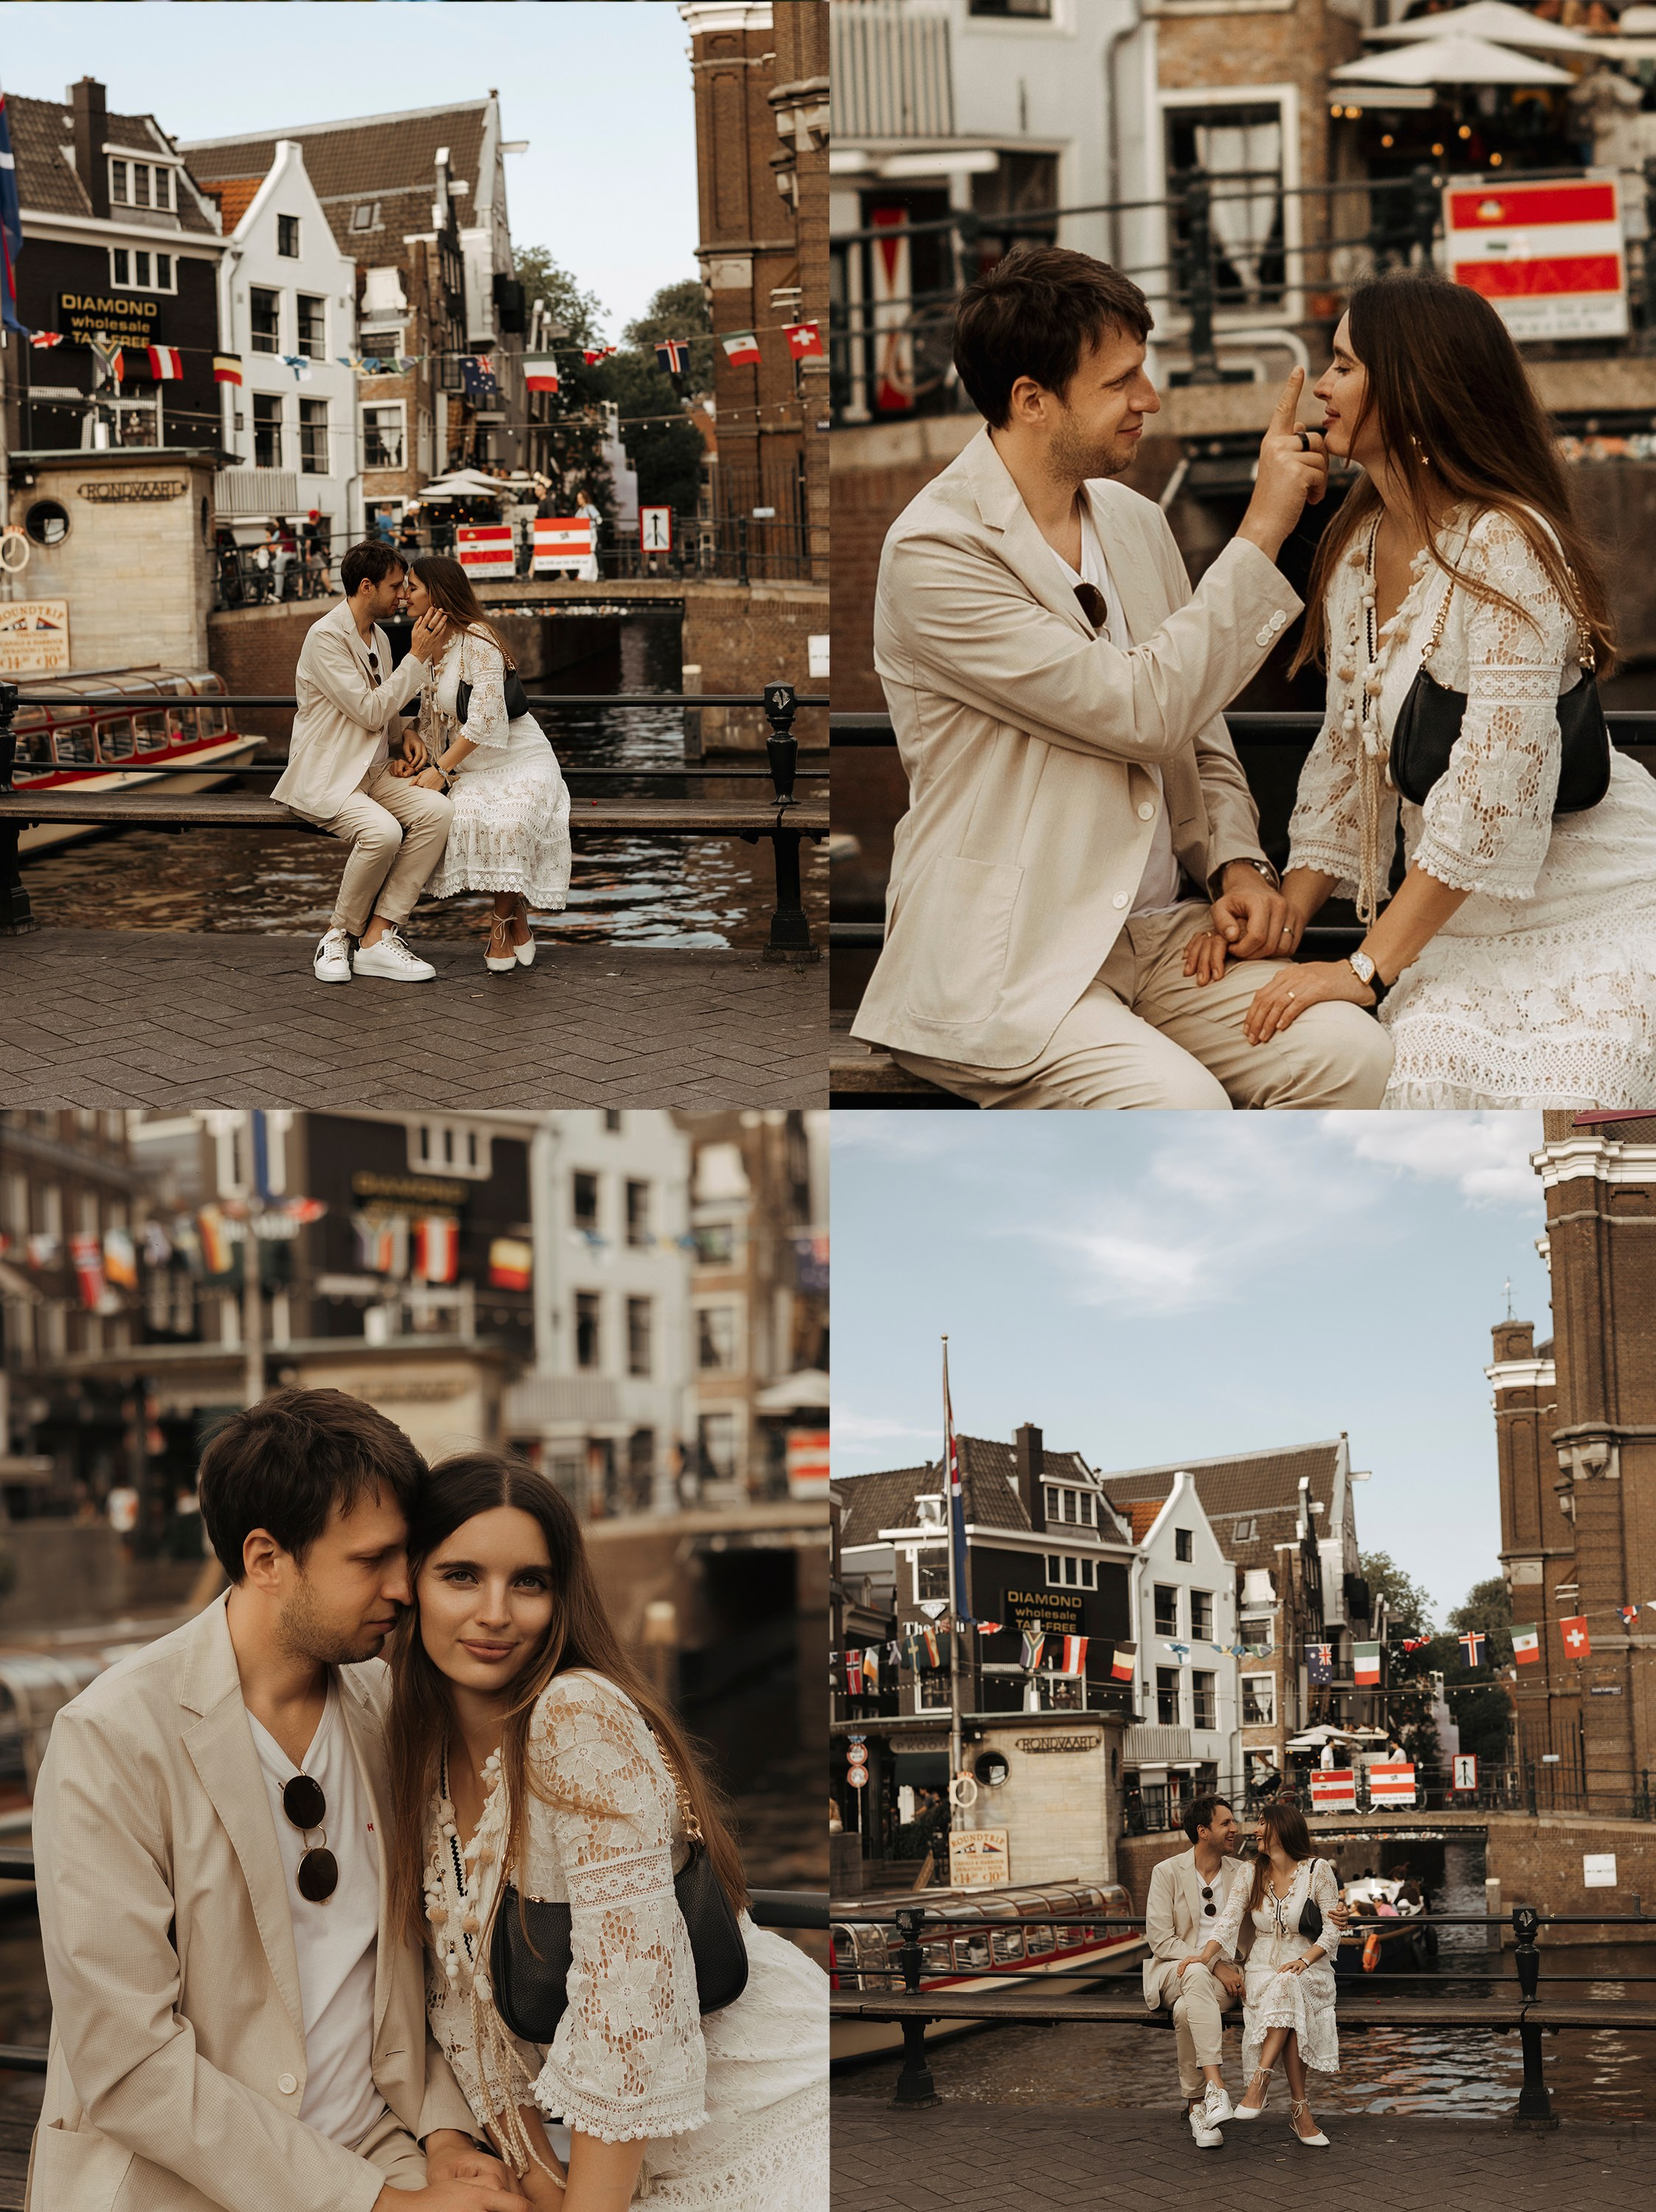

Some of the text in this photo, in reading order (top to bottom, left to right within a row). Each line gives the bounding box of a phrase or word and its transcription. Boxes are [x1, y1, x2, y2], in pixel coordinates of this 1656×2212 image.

[61, 293, 157, 317] DIAMOND
[71, 315, 150, 333] wholesale
[1007, 1590, 1082, 1608] DIAMOND
[1015, 1607, 1077, 1621] wholesale
[902, 1621, 932, 1635] The
[1016, 1619, 1077, 1633] TA-FREE
[1023, 1736, 1094, 1750] RONDVAART
[366, 1823, 375, 1832] H
[952, 1834, 1005, 1848] ROUNDTRIP
